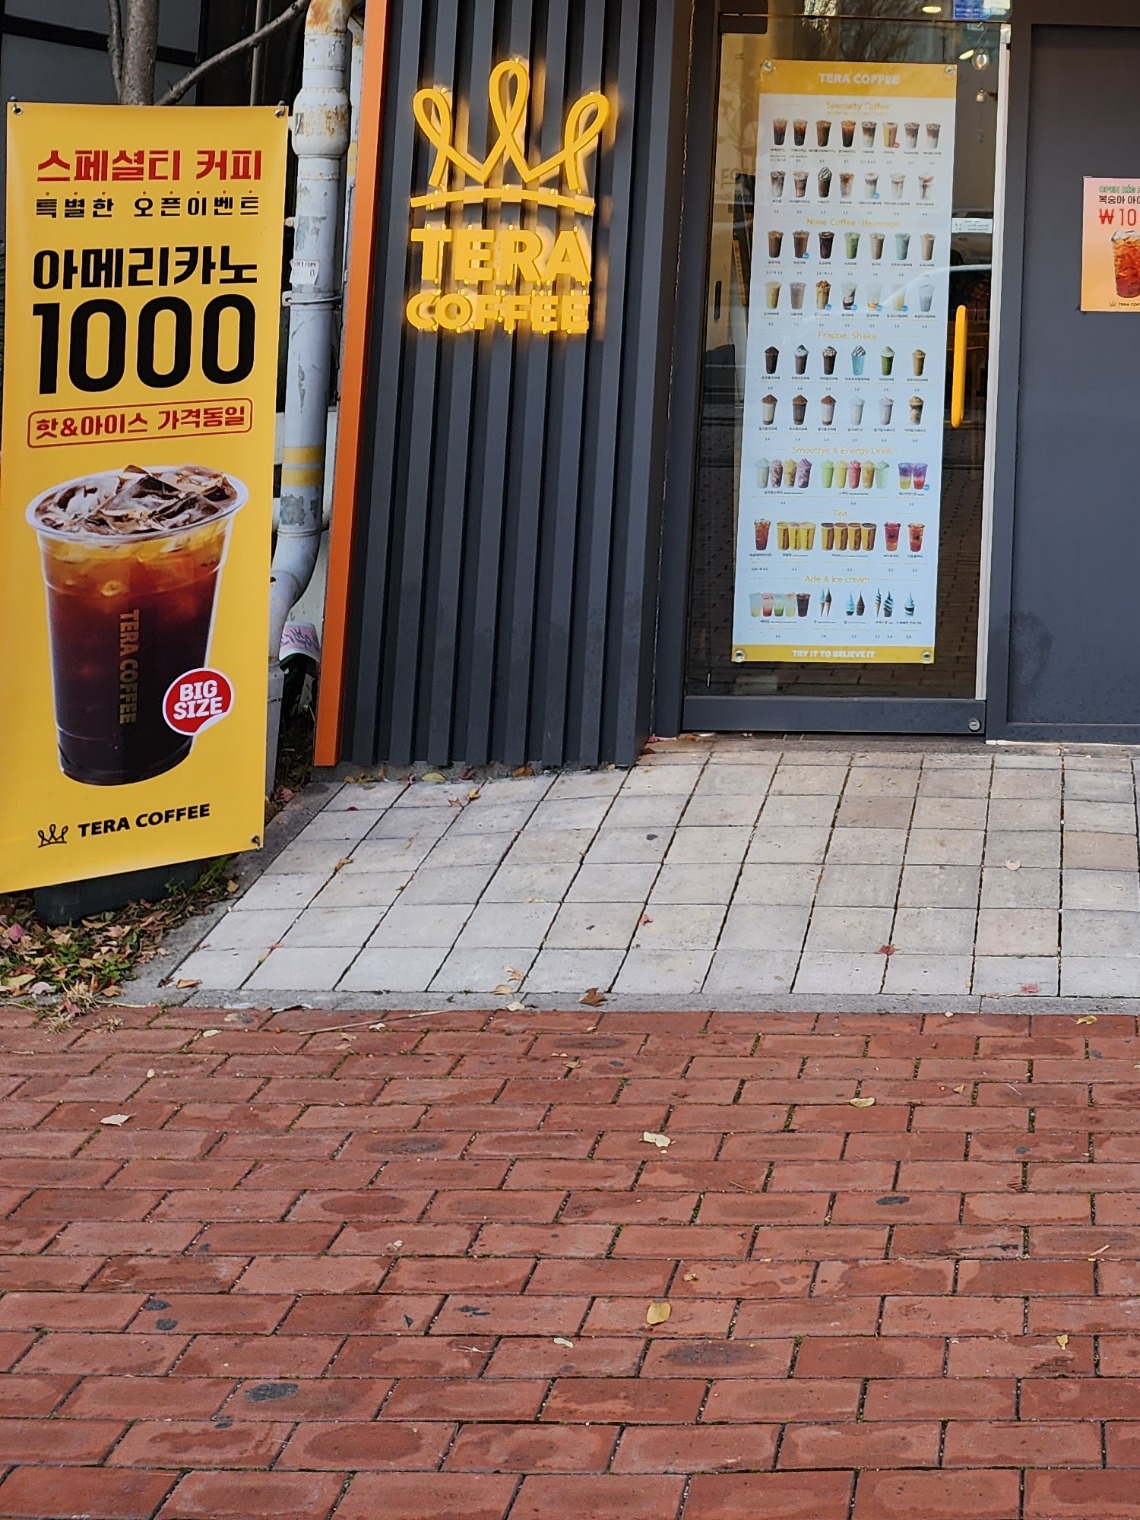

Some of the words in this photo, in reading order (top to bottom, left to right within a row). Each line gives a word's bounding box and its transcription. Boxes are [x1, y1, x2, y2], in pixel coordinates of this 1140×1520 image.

[818, 72, 850, 84] TERA
[853, 73, 900, 85] COFFEE
[37, 150, 181, 182] 스페셜티
[196, 150, 262, 181] 커피
[35, 198, 115, 219] 특별한
[133, 196, 260, 218] 오픈이벤트
[1099, 194, 1125, 205] 복숭아
[32, 245, 258, 290] 아메리카노
[411, 228, 592, 282] TERA
[406, 292, 590, 333] COFFEE
[32, 293, 256, 395] 1000
[35, 412, 148, 441] 핫&아이스
[158, 406, 246, 431] 가격동일
[119, 609, 140, 657] TERA
[118, 658, 139, 725] COFFEE
[173, 696, 224, 720] SIZE
[179, 679, 219, 702] BIG
[78, 816, 130, 838] TERA
[135, 803, 211, 828] COFFEE
